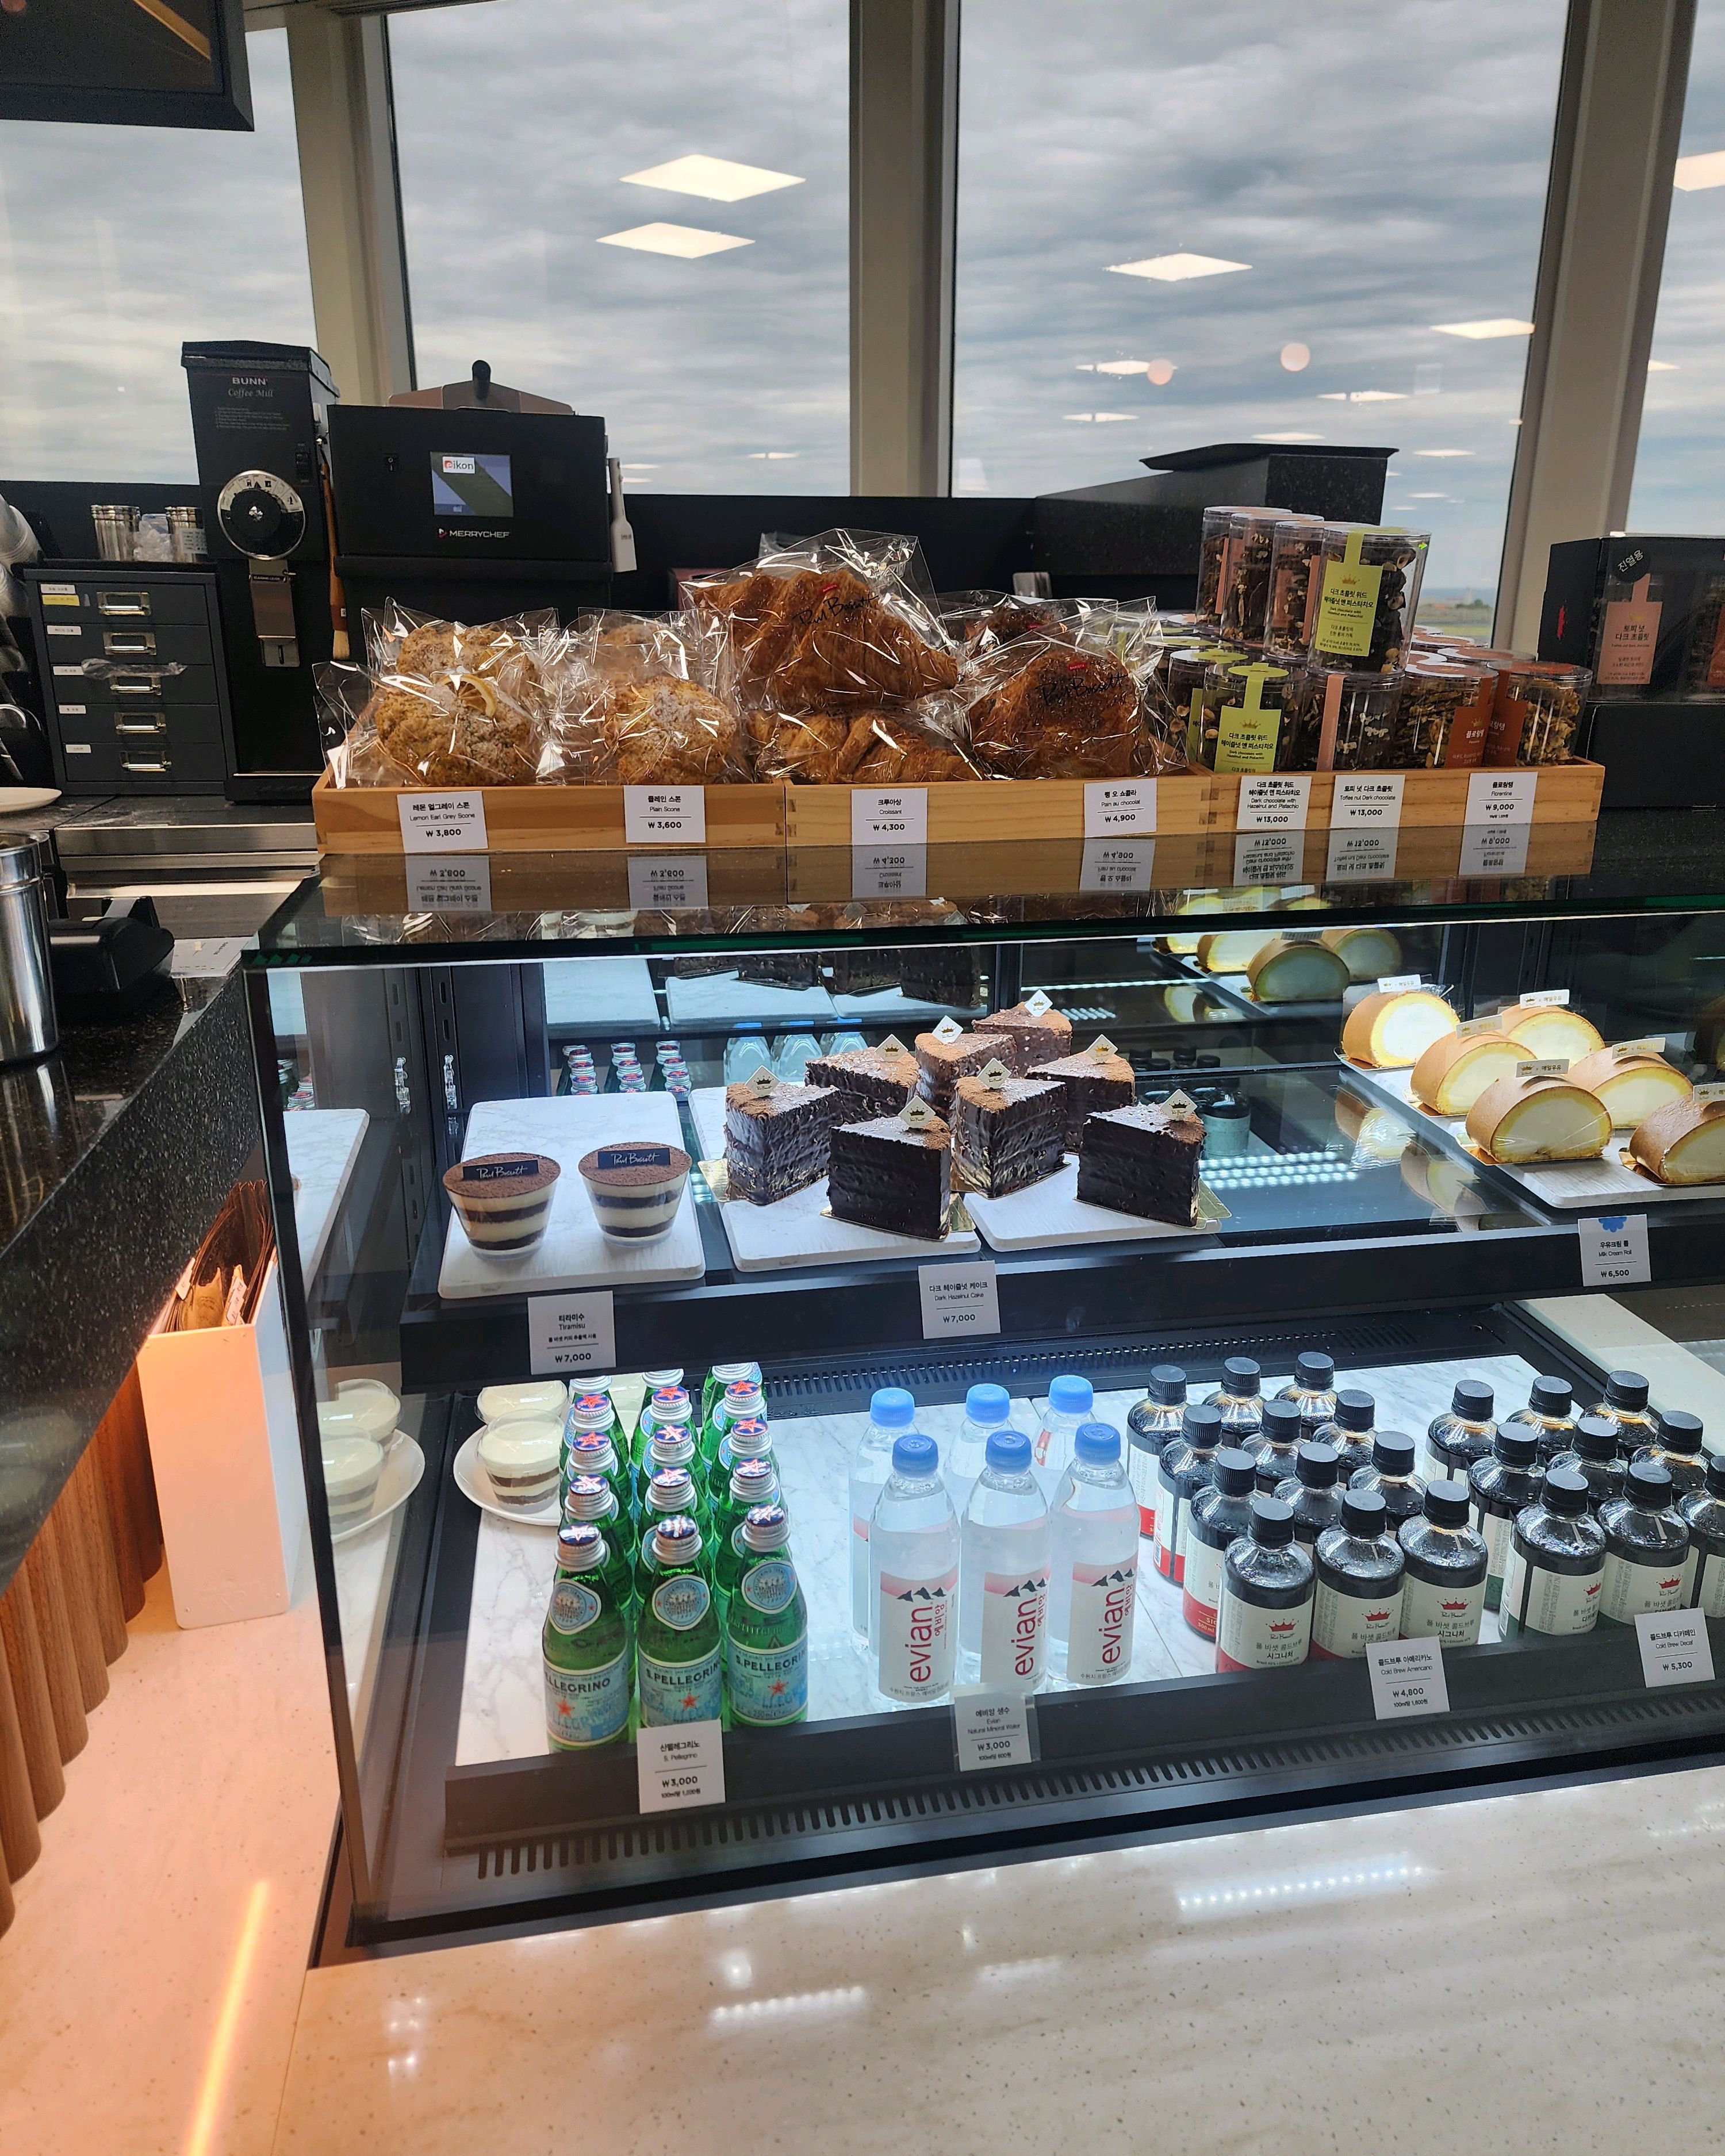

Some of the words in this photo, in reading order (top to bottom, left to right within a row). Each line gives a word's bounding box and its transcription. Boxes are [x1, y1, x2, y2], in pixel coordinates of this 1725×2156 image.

[232, 377, 266, 385] BUNN
[228, 388, 253, 398] Coffee
[444, 460, 474, 469] eikon
[1617, 550, 1644, 573] 진열용
[1347, 600, 1374, 608] 피스타치오
[428, 803, 454, 811] 얼그레이
[1113, 814, 1136, 822] 4,900
[436, 829, 461, 837] 3,800
[1608, 1269, 1629, 1278] 6,500
[944, 1283, 968, 1291] 헤이즐넛
[558, 1313, 584, 1322] 티라미수
[951, 1314, 975, 1323] 7,000
[565, 1353, 591, 1363] 7,000
[934, 1603, 945, 1636] 에비앙
[1098, 1587, 1125, 1664] evian
[1011, 1597, 1037, 1675] evian
[1650, 1632, 1672, 1641] 콜드브루
[1674, 1629, 1696, 1637] 디카페인
[905, 1605, 933, 1682] evian
[1267, 1651, 1293, 1659] 시그니처
[735, 1651, 805, 1671] S.PELLEGRIN
[1378, 1657, 1401, 1666] 콜드브루
[1403, 1654, 1433, 1663] 아메리카노
[1671, 1662, 1692, 1670] 5,300
[1401, 1688, 1424, 1697] 4,800
[976, 1709, 995, 1717] 에비앙
[986, 1741, 1010, 1751] 3,000
[671, 1776, 697, 1787] 3,000
